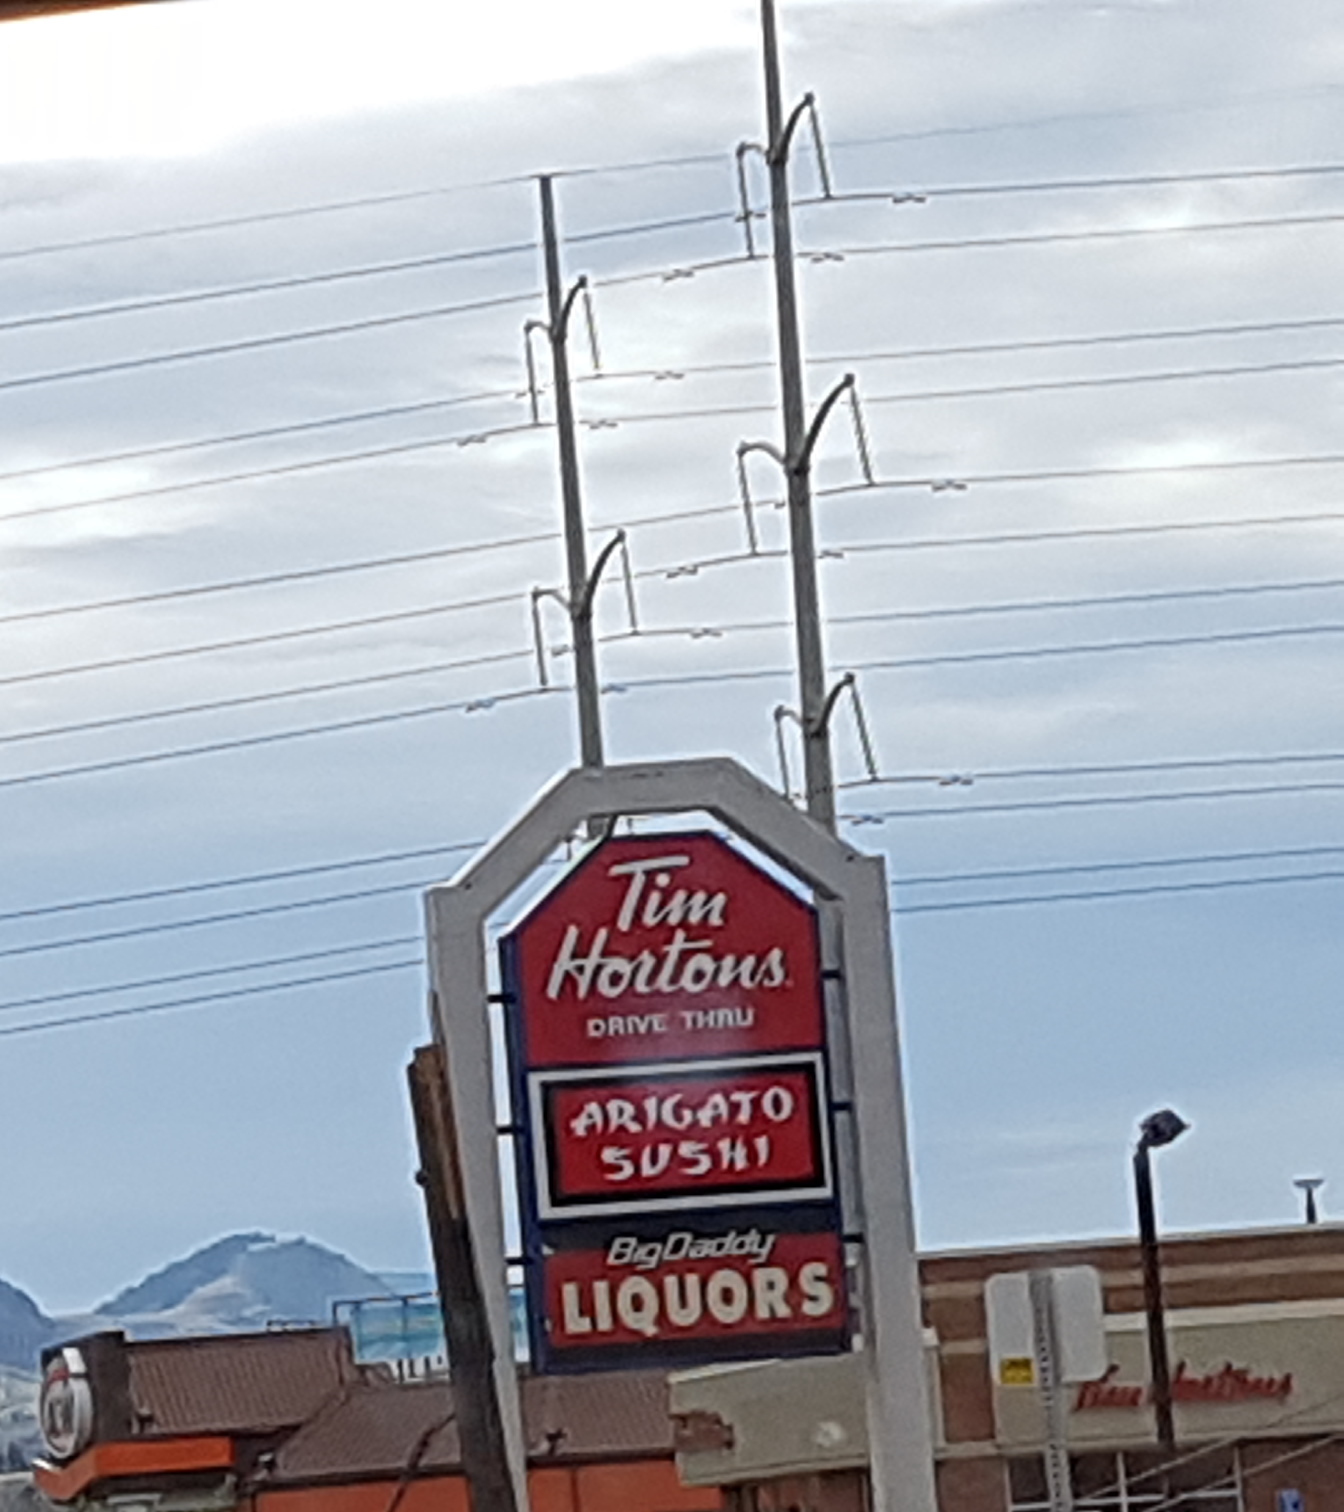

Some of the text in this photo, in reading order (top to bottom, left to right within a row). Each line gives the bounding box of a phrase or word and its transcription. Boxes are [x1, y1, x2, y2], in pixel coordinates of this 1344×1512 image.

[608, 855, 727, 932] Tim
[546, 924, 786, 1000] Hortons
[586, 1007, 754, 1038] DRIVE THRU
[570, 1086, 793, 1137] ARIGATO
[600, 1134, 770, 1181] SUSHI
[563, 1261, 834, 1338] LIQUORS
